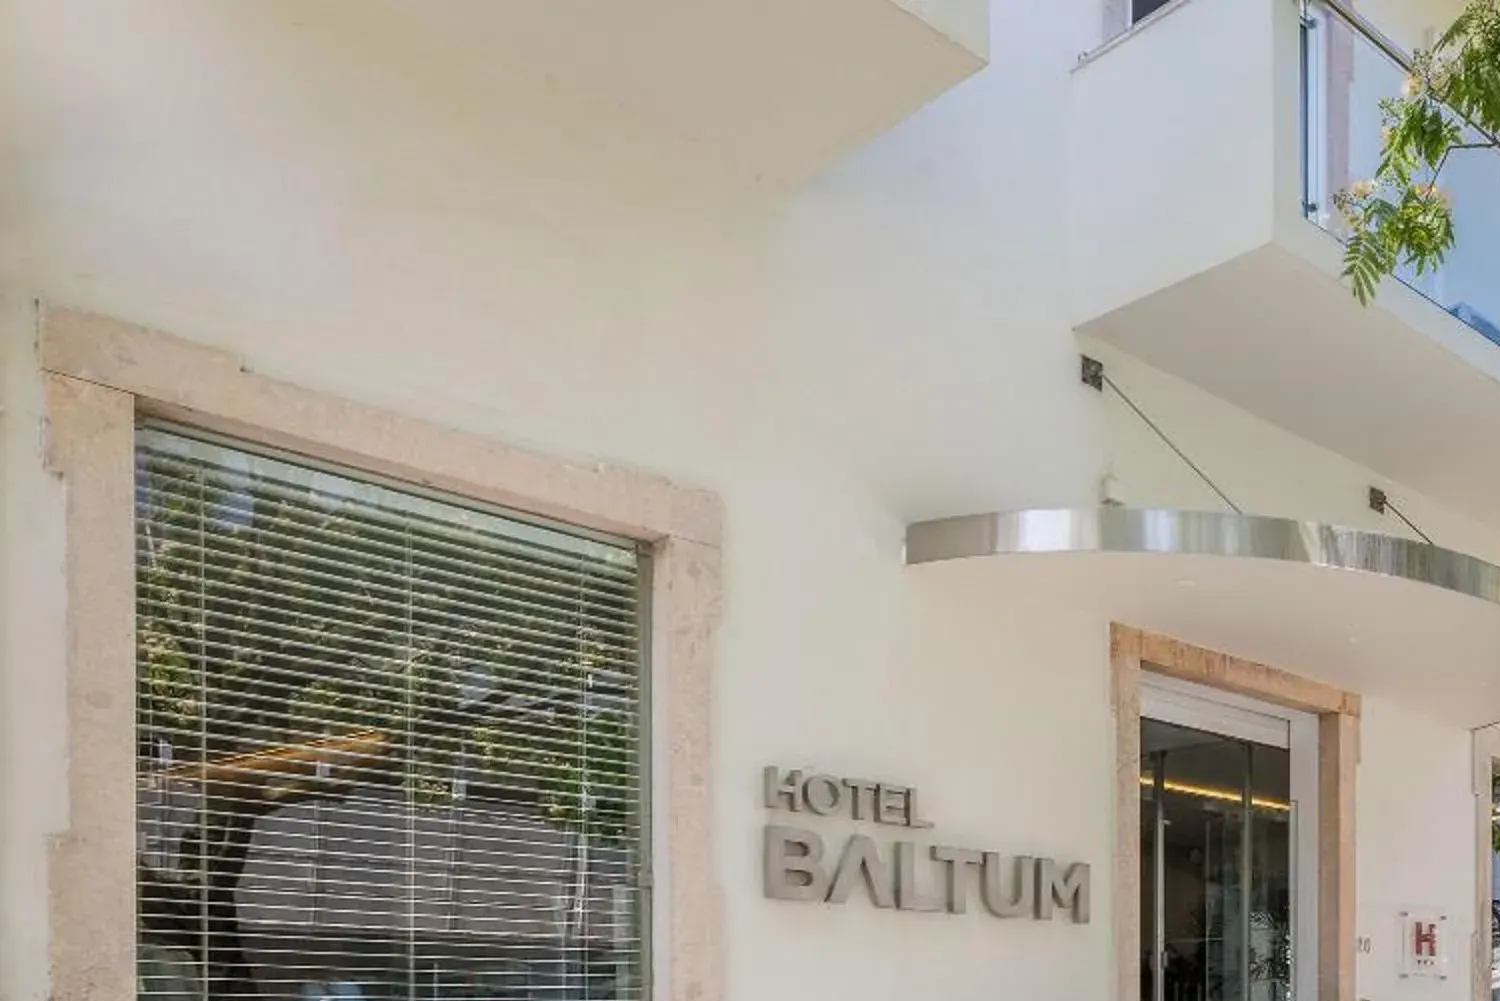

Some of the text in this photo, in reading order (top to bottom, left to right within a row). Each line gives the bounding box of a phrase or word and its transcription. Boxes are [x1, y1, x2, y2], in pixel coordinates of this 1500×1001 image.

[763, 765, 935, 829] HOTEL
[763, 825, 1091, 924] BALTUM
[1415, 921, 1437, 957] H
